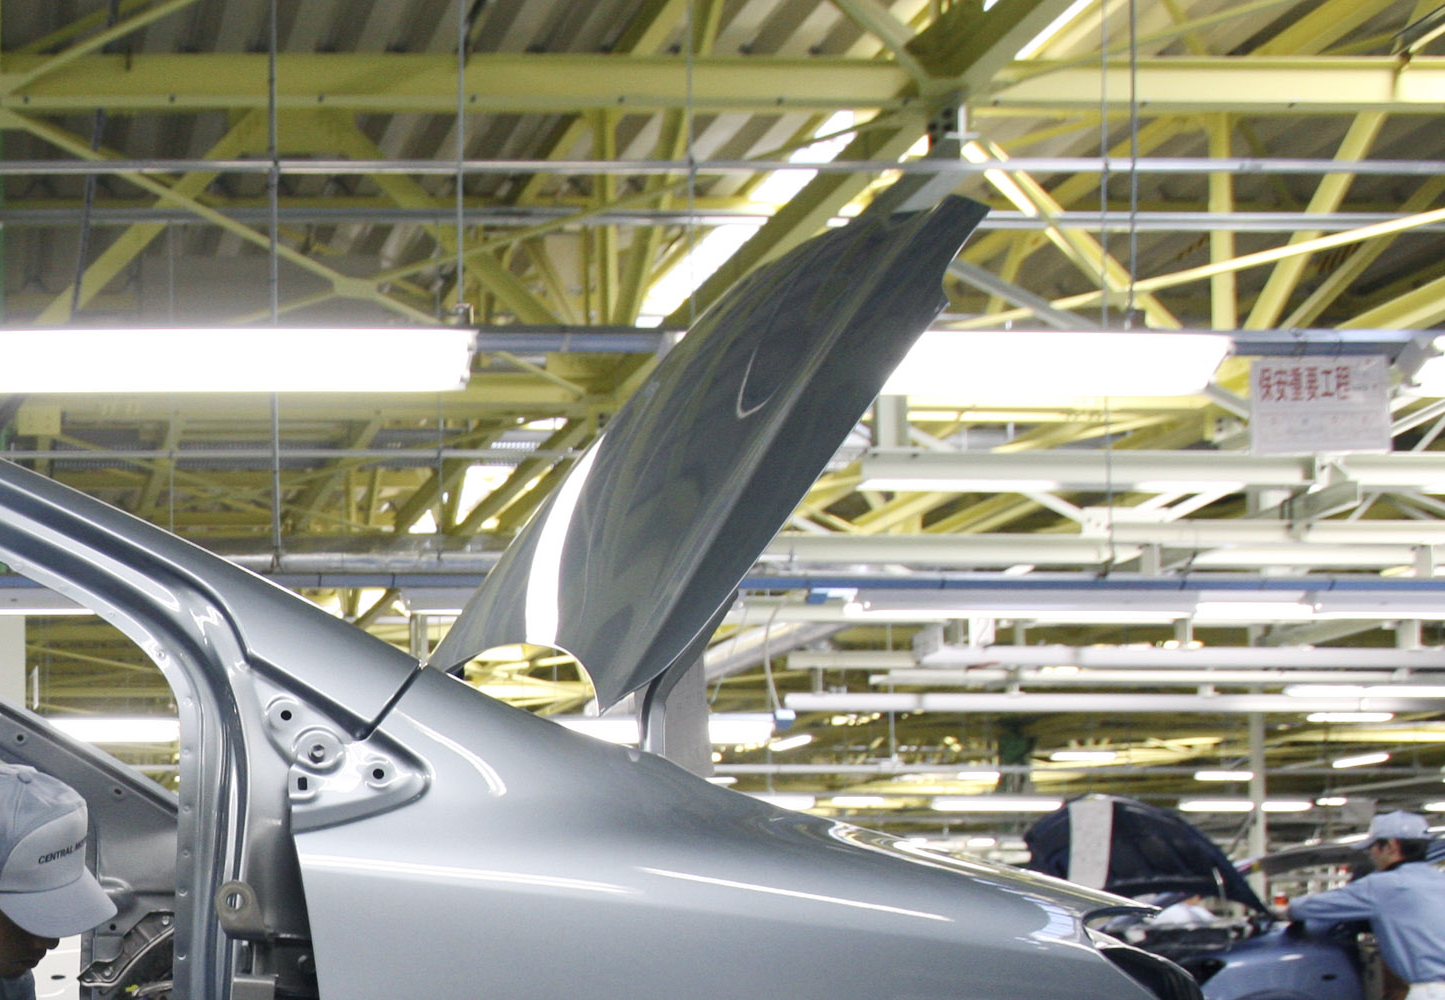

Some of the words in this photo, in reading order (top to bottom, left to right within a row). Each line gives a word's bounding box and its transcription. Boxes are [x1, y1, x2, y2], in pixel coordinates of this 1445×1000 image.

[1259, 366, 1351, 401] 保安重要工程
[38, 845, 73, 864] CENTRAL
